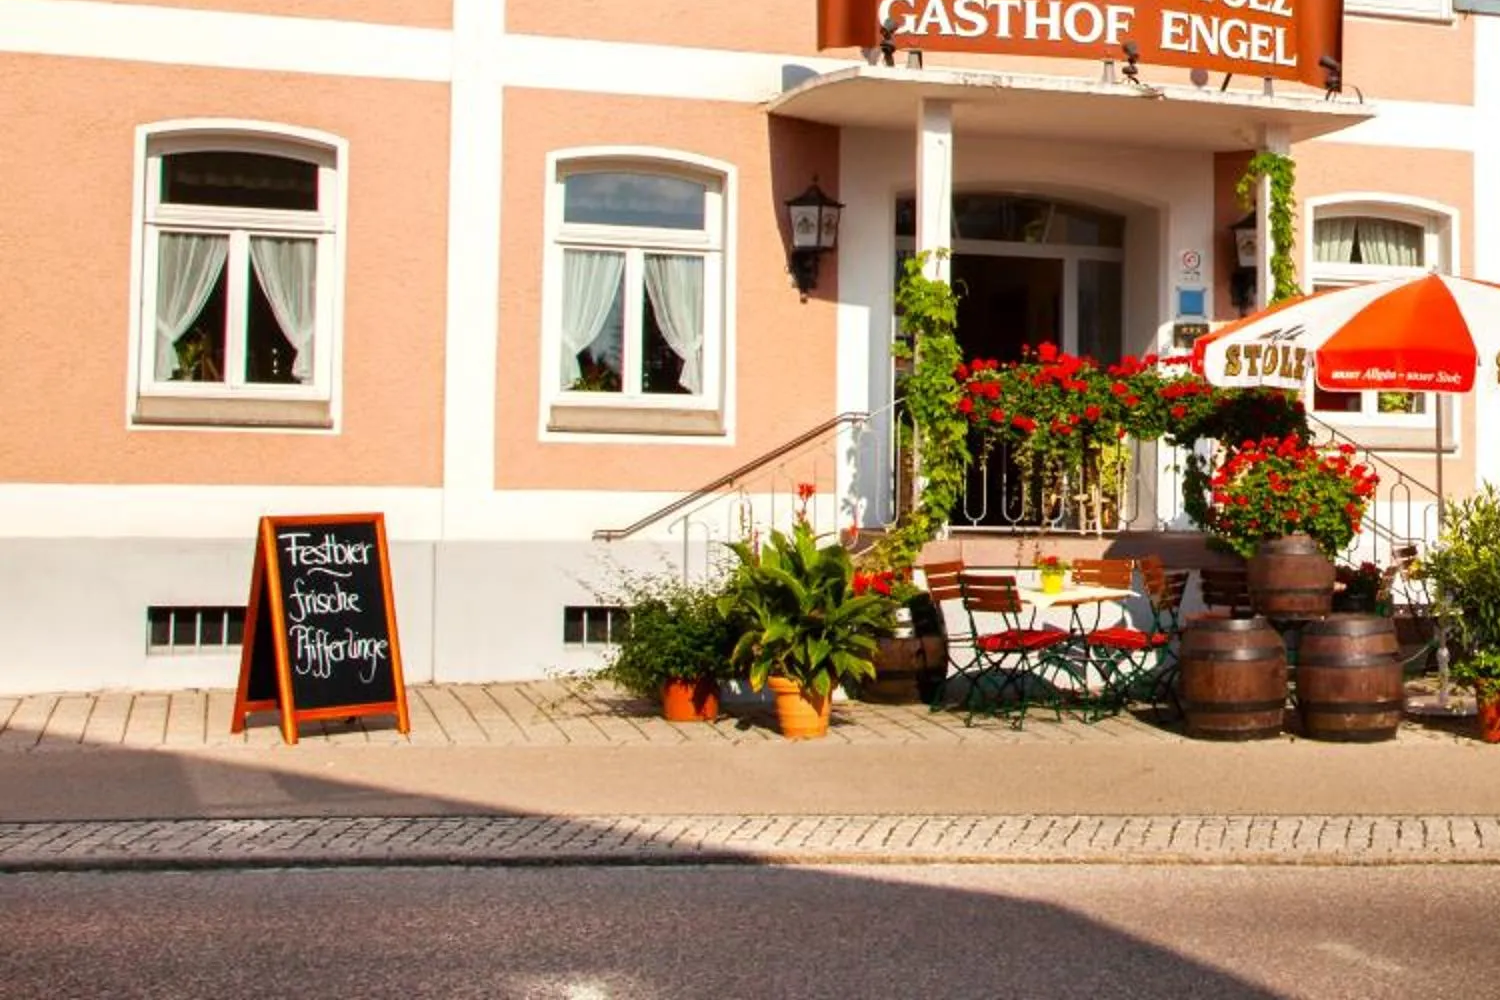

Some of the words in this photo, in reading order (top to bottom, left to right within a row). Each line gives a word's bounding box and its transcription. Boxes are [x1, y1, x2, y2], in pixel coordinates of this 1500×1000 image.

[1160, 9, 1297, 67] ENGEL
[278, 532, 374, 566] Festbier
[289, 578, 362, 622] frische
